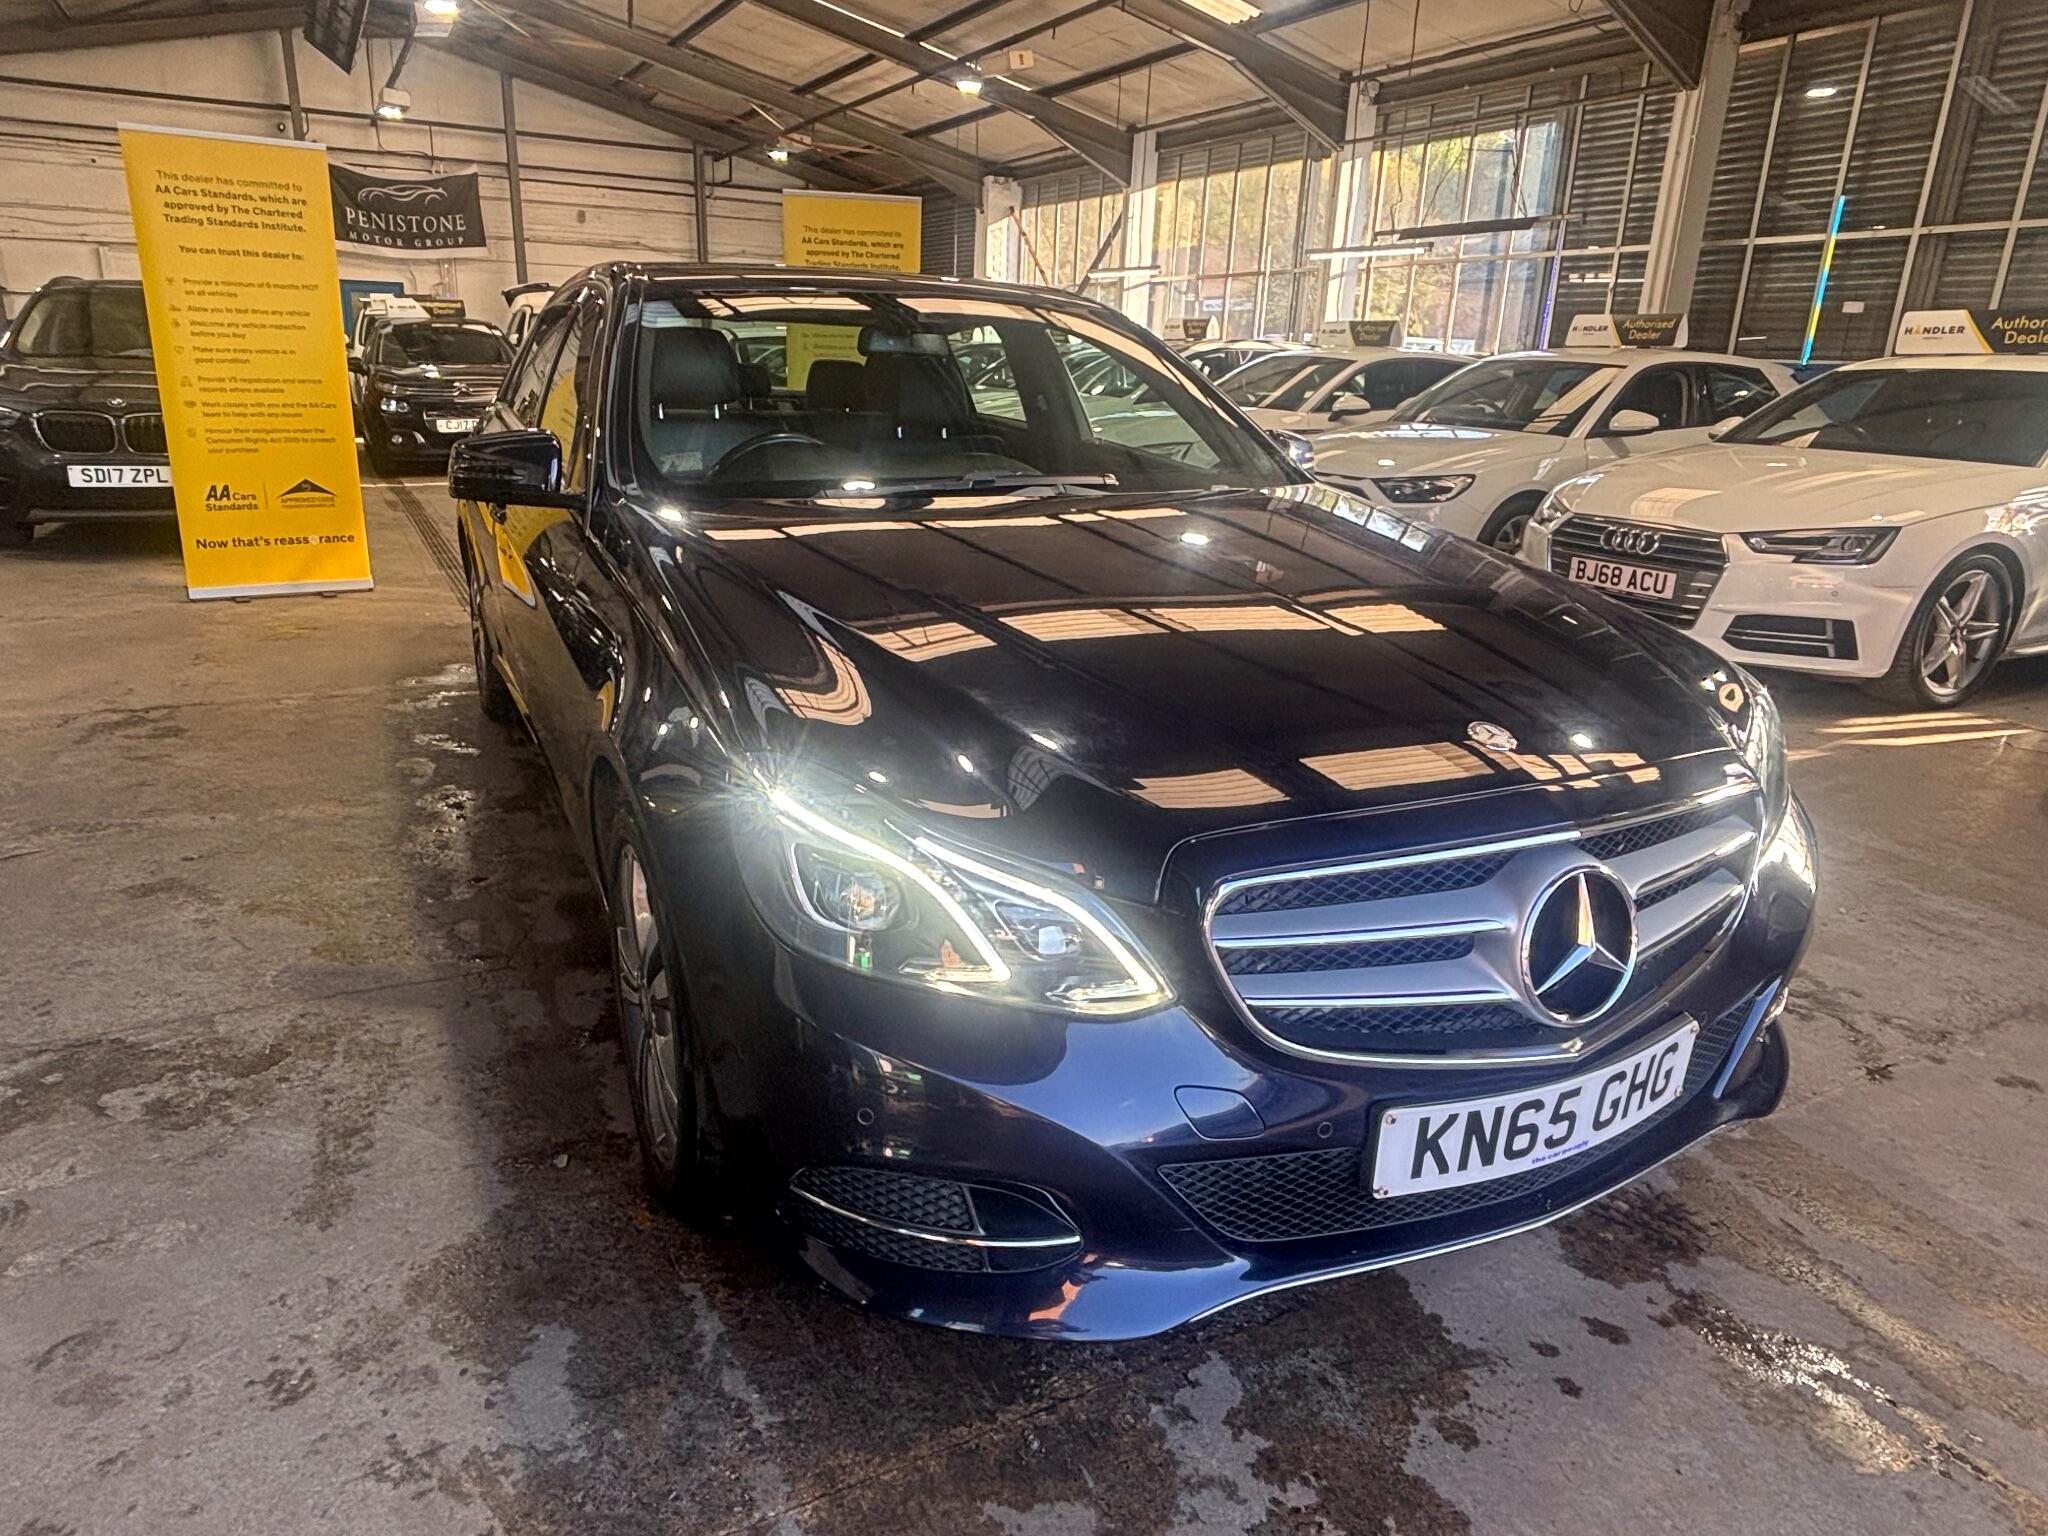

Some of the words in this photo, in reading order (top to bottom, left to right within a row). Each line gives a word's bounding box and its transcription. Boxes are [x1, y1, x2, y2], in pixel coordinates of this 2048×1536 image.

[156, 170, 178, 180] This
[181, 173, 213, 183] dealer
[216, 176, 234, 186] has
[237, 179, 289, 191] committed
[293, 183, 302, 192] to
[156, 185, 171, 194] AA
[173, 186, 198, 196] Cars
[201, 189, 257, 202] Standards,
[259, 194, 289, 204] which
[163, 201, 214, 212] approved
[217, 203, 229, 215] by
[231, 206, 249, 215] The
[253, 207, 303, 219] Chartered
[163, 213, 204, 226] Trading
[206, 218, 258, 229] Standards
[262, 222, 307, 232] Institute.
[345, 206, 466, 233] PENISTONE
[804, 225, 818, 233] This
[349, 231, 404, 247] MOTOR
[414, 237, 464, 247] GROUP
[814, 237, 829, 245] Cars
[178, 244, 197, 254] You
[199, 247, 216, 255] can
[218, 247, 240, 256] trust
[242, 249, 260, 258] this
[262, 251, 290, 260] dealer
[292, 252, 304, 260] to:
[841, 250, 849, 258] by
[865, 251, 900, 259] Chartered
[1623, 318, 1677, 329] Authorised
[1629, 329, 1661, 339] Dealer
[81, 468, 123, 483] SD17
[130, 468, 169, 483] ZPL
[206, 484, 231, 501] AA
[206, 502, 258, 512] Standards
[196, 538, 228, 549] Now
[232, 536, 271, 548] that's
[274, 533, 354, 545] reassrance
[1575, 561, 1622, 586] BJ68
[1627, 569, 1668, 594] ACU
[1410, 1086, 1582, 1180] KN65
[1592, 1042, 1679, 1131] GHG
